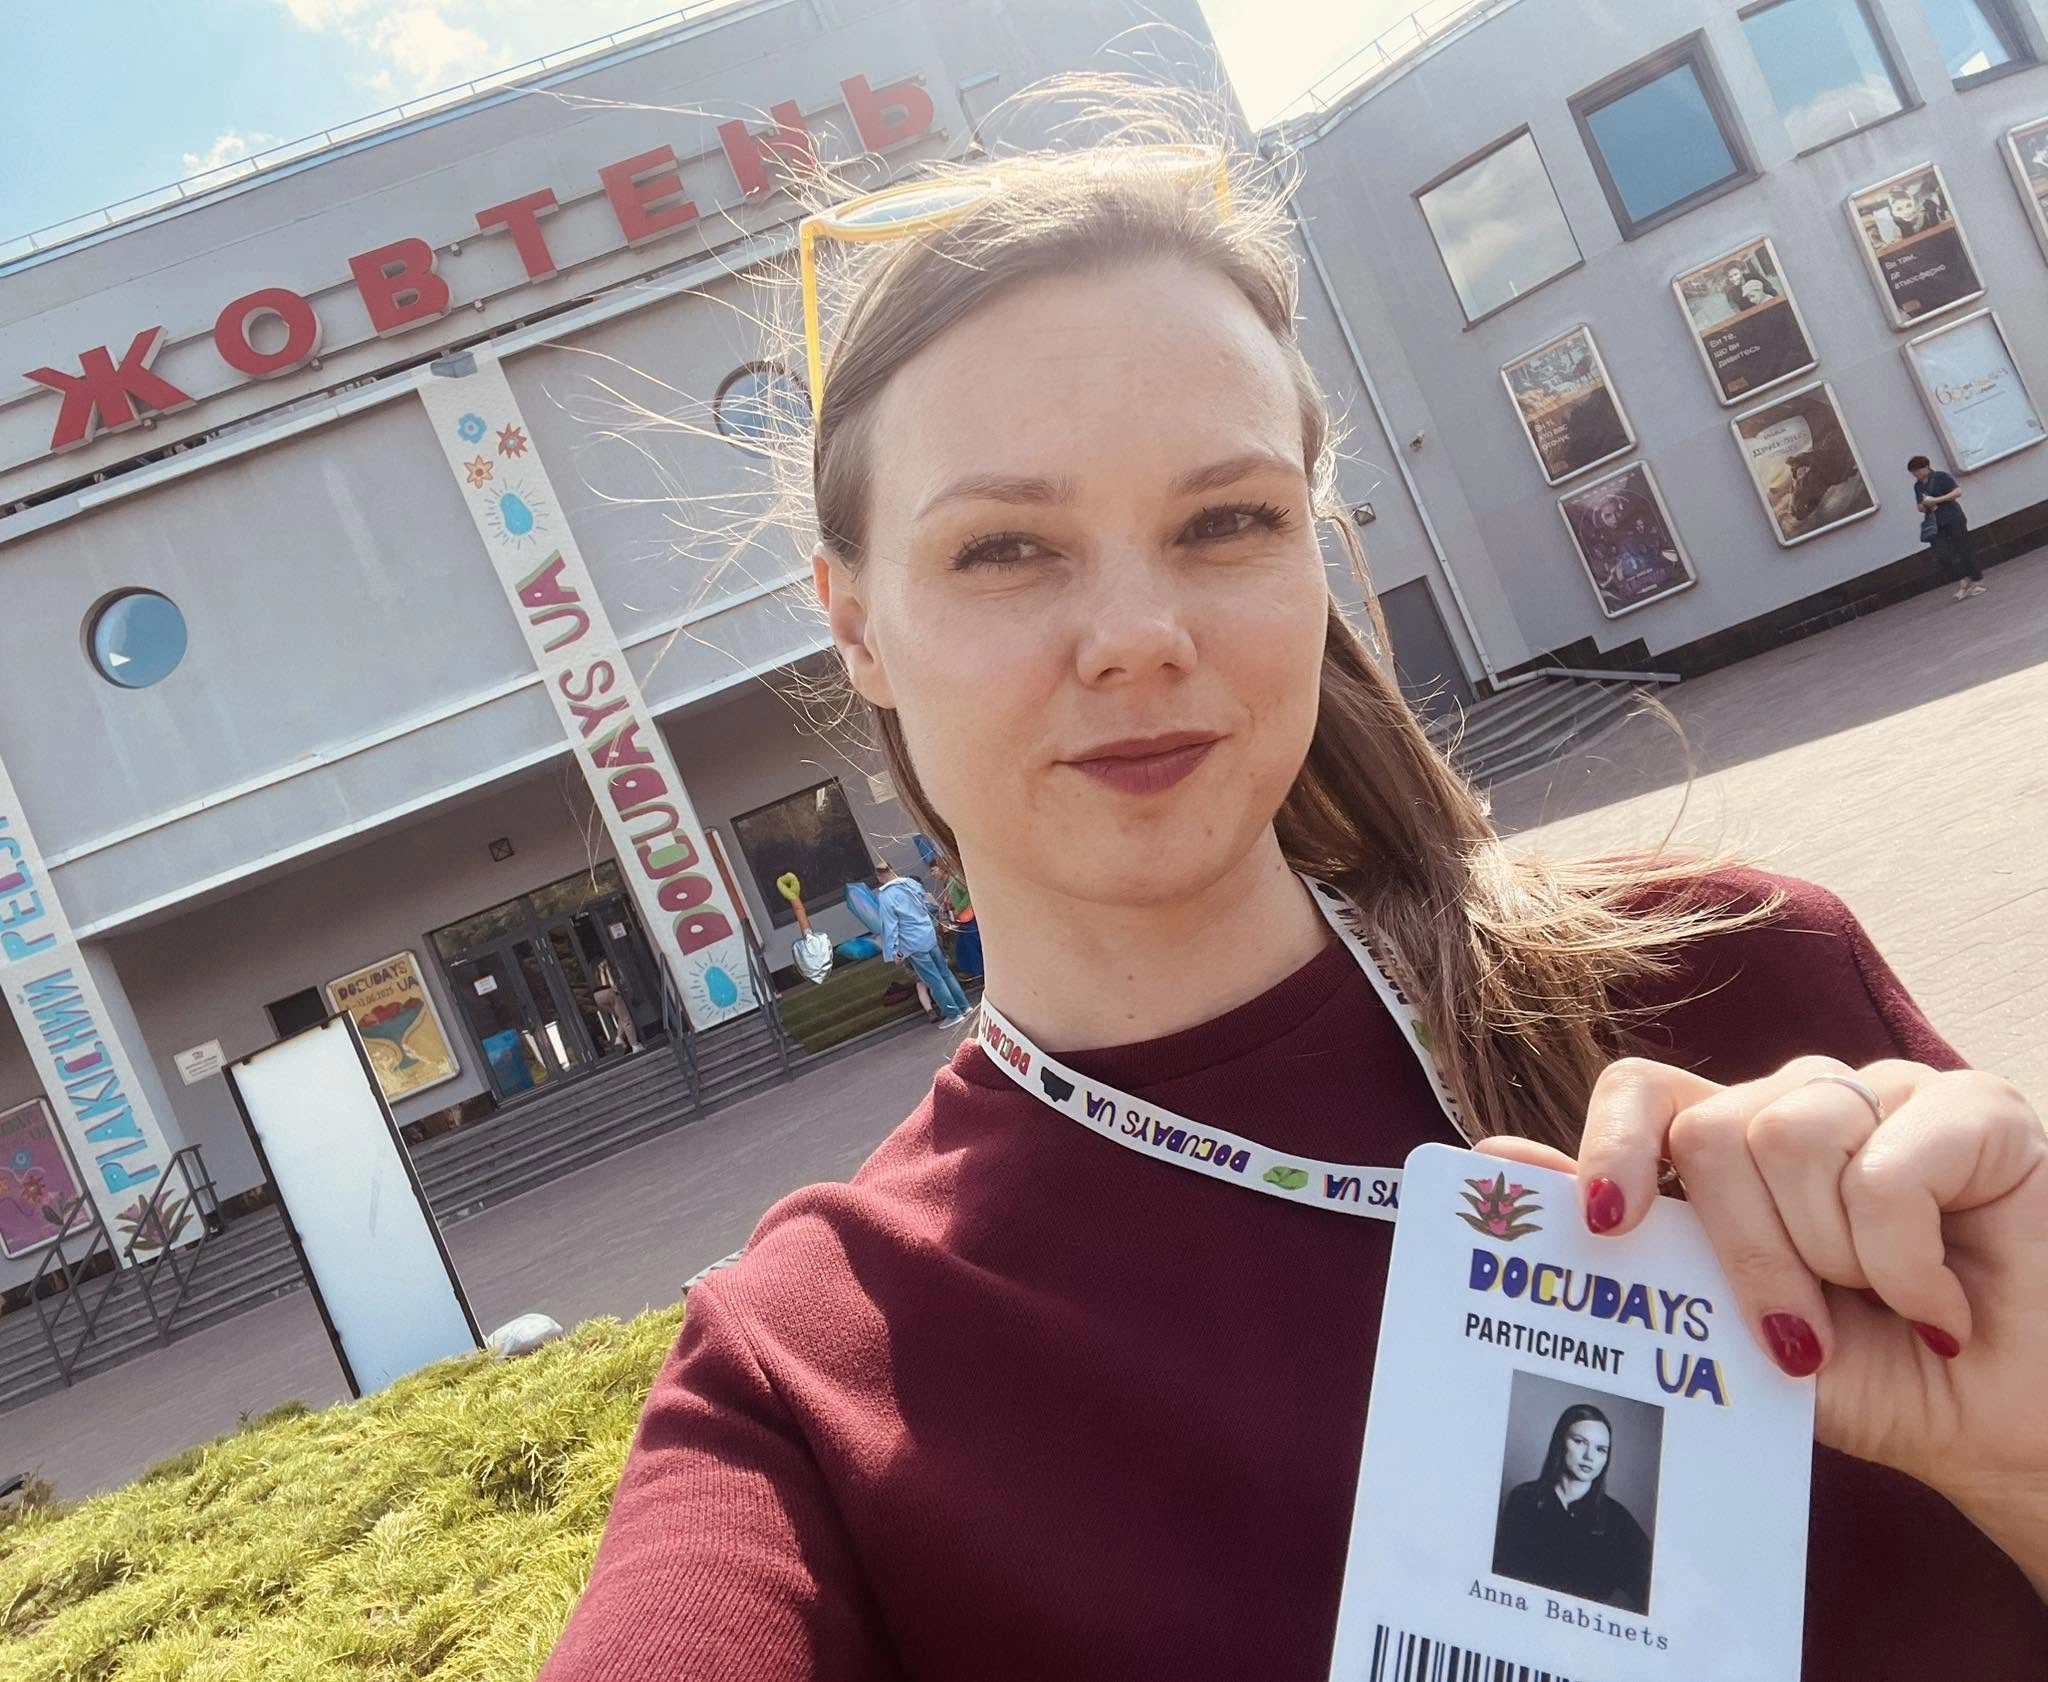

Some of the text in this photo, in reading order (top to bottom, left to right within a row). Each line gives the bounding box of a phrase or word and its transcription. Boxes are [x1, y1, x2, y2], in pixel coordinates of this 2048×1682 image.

[22, 73, 936, 454] ЖОВТЕНЬ
[1714, 342, 1740, 358] що ви
[1718, 345, 1760, 369] дивитесь
[514, 549, 734, 957] DOCUDAYS UA
[338, 960, 408, 1000] DOCUDAYS
[396, 976, 419, 993] UA
[16, 968, 161, 1194] РІДКІСНИЙ
[1086, 1090, 1251, 1173] DOCUDAYS UA
[1323, 1174, 1361, 1202] UA
[1469, 1248, 1714, 1342] DOCUDAYS
[1465, 1312, 1625, 1375] PARTICIPANT
[1656, 1348, 1731, 1407] UA
[1468, 1579, 1669, 1650] Anna Babinets
